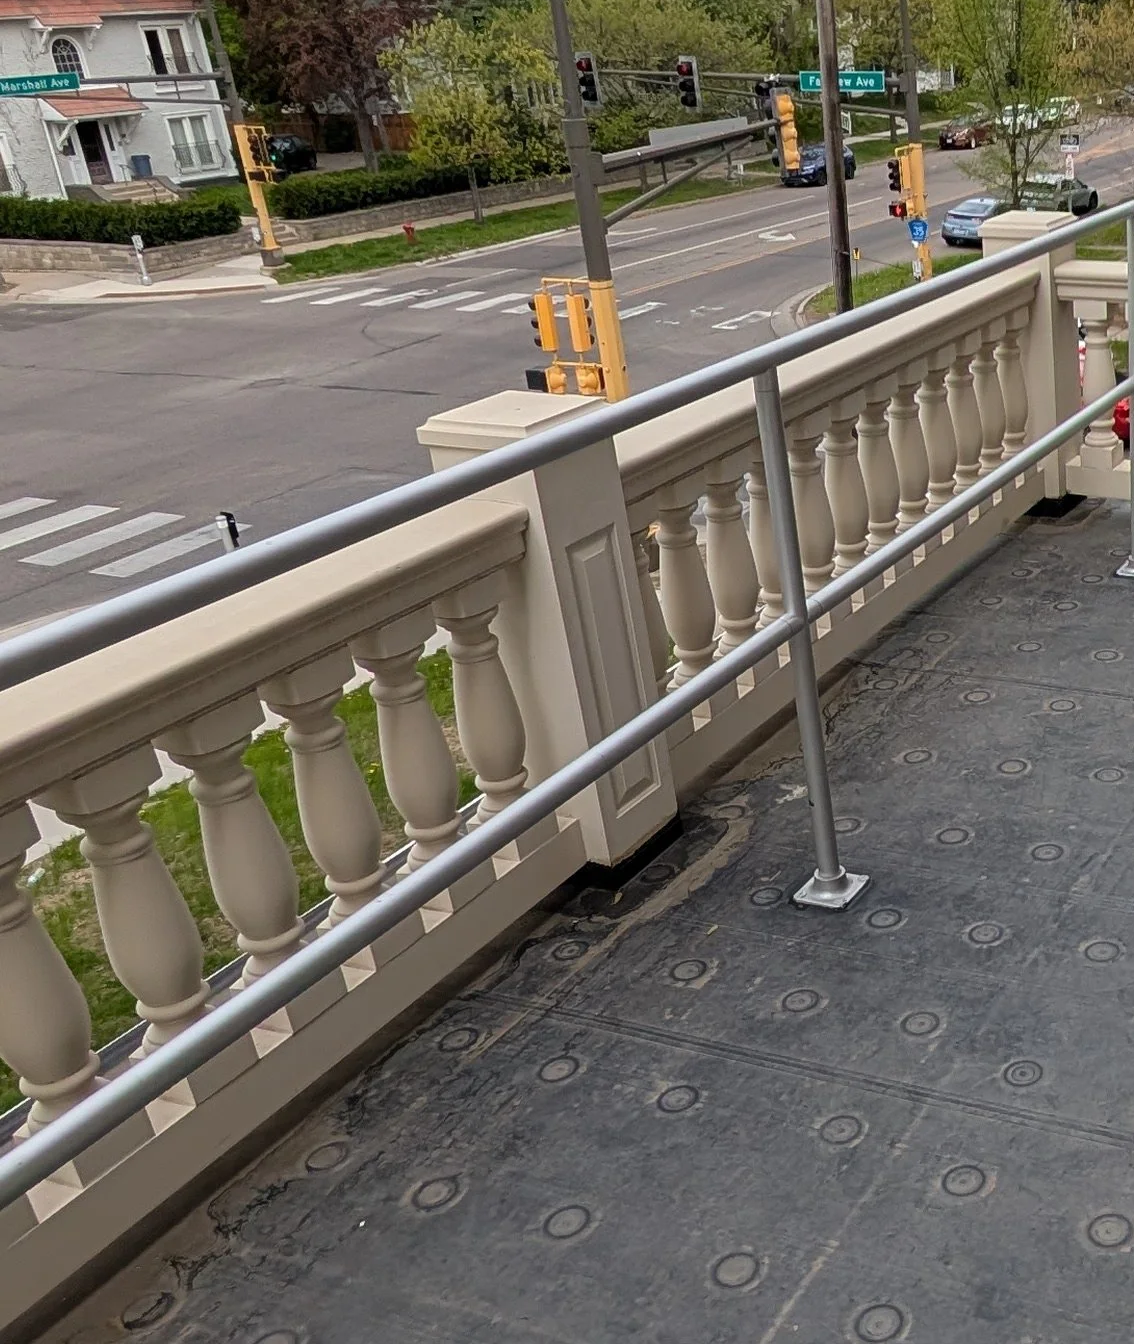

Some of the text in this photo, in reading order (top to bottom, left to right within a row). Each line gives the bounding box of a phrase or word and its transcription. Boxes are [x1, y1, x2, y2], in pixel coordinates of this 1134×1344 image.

[0, 78, 70, 92] Marshall Ave
[809, 76, 875, 87] Faew Ave
